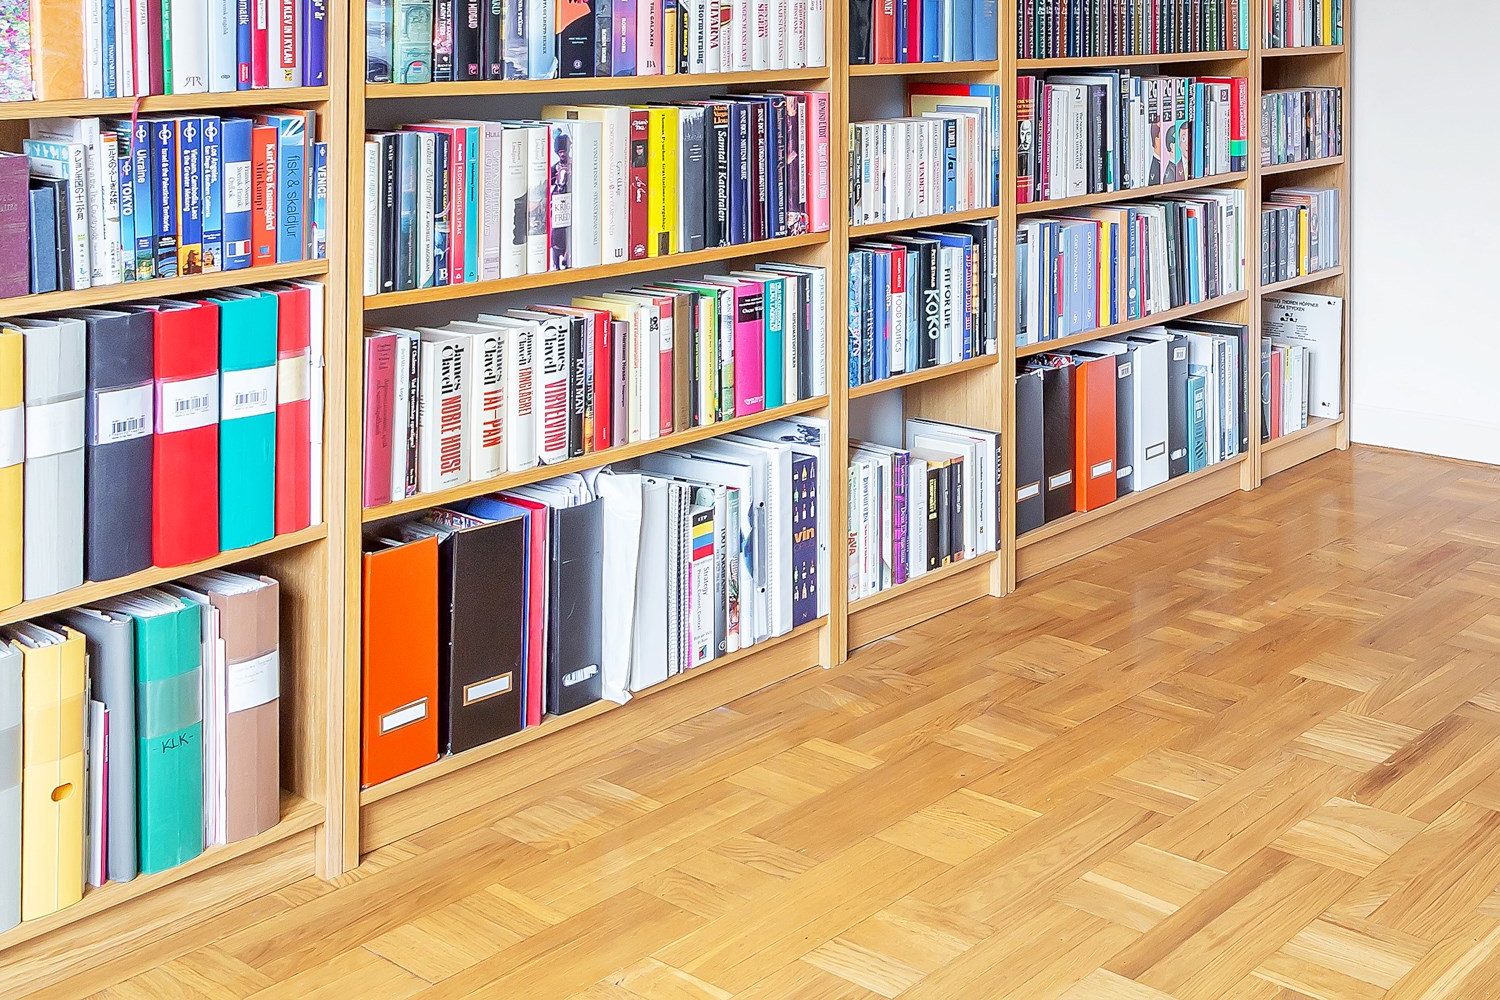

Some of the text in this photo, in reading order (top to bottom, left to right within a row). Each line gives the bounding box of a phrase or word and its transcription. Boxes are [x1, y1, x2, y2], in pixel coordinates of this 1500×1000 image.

[284, 6, 293, 24] KLEV
[696, 4, 705, 65] Stormvarning
[757, 3, 765, 39] SEGERN
[284, 39, 293, 63] KYLAN
[137, 149, 147, 183] Ukraine
[266, 144, 275, 162] Karl
[718, 131, 727, 163] Samtal
[266, 164, 274, 182] Ove
[317, 166, 326, 199] VENICE
[123, 182, 132, 216] TOKYO
[284, 156, 300, 238] fisk & skaldjur
[717, 172, 727, 222] Katedralen
[924, 289, 940, 340] KOKO
[441, 345, 453, 394] Clavell
[453, 345, 465, 391] James
[483, 338, 496, 386] Clavell
[496, 336, 505, 382] James
[519, 332, 527, 366] Clavell
[544, 325, 557, 375] Clavell
[558, 325, 568, 372] James
[576, 358, 584, 414] RAIN MAN
[441, 395, 461, 476] NOBLE HOUSE
[544, 379, 567, 452] VIRVELVIND
[794, 526, 815, 544] vin
[848, 532, 857, 556] JAVA
